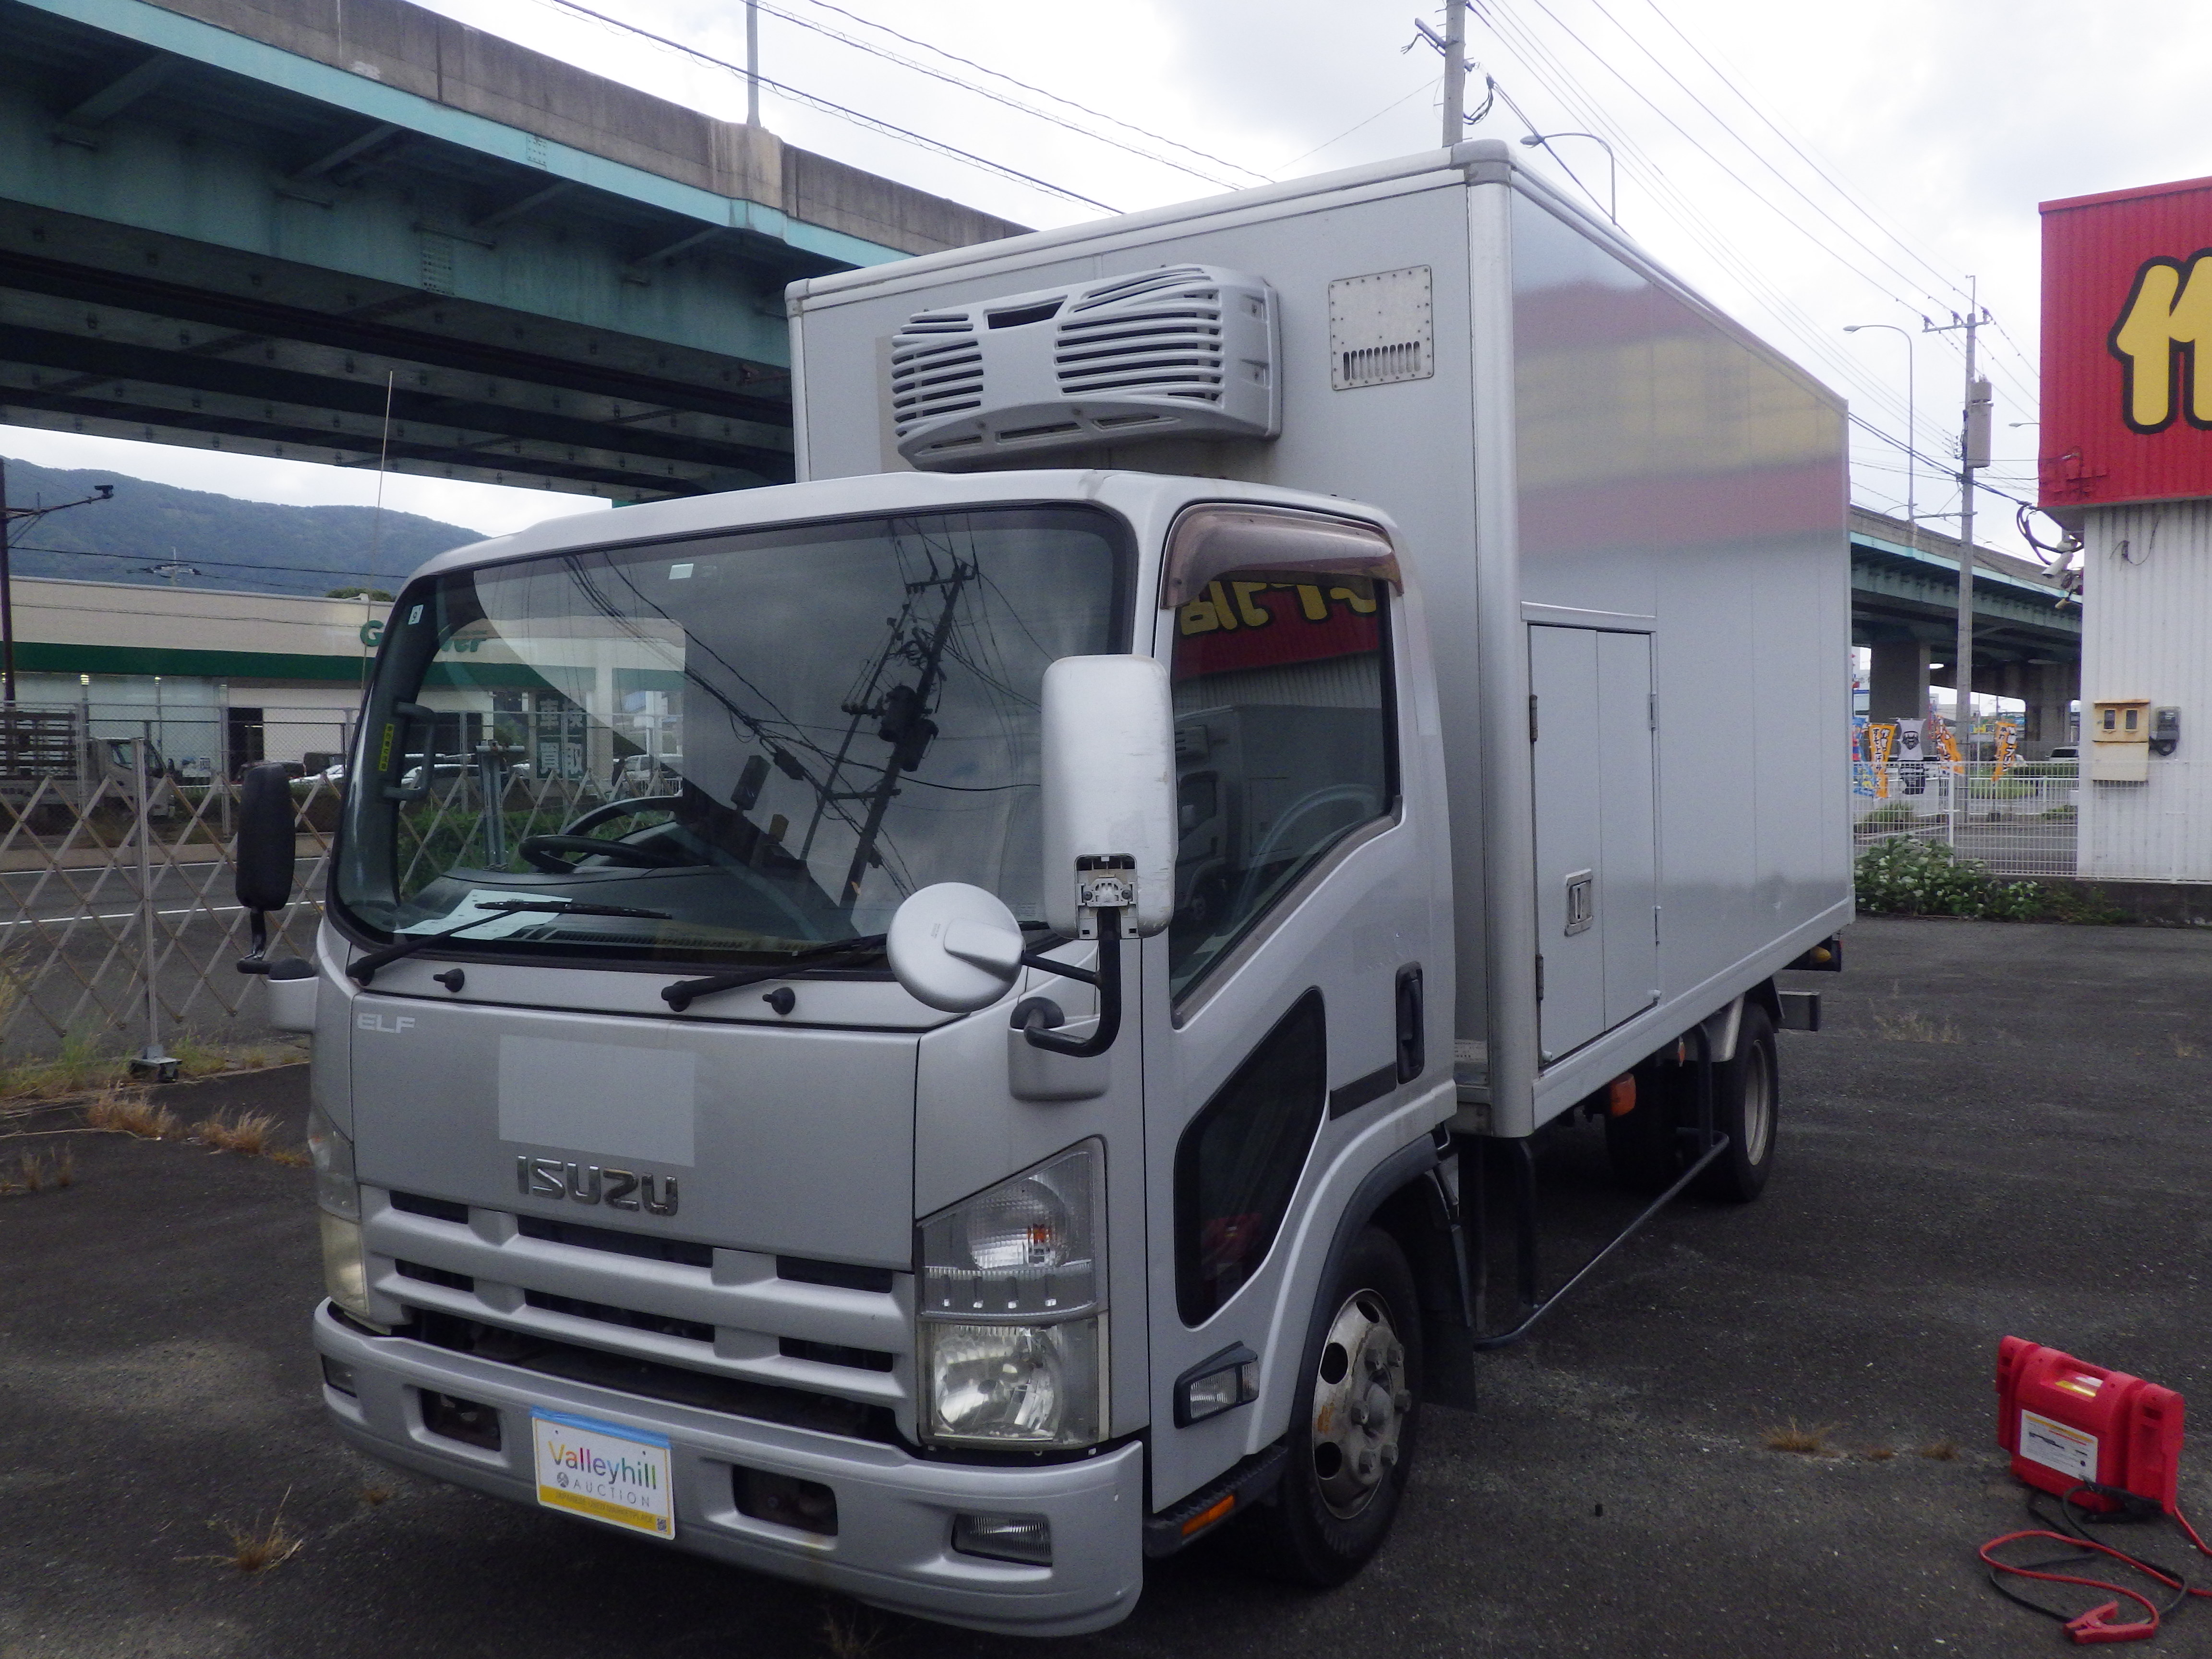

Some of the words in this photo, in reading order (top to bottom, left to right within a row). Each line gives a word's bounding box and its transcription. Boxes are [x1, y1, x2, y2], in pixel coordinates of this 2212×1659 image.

[357, 1012, 416, 1034] ELF
[517, 1154, 678, 1217] ISUZU
[547, 1440, 657, 1490] Valleyhill
[573, 1479, 650, 1508] AUCTION
